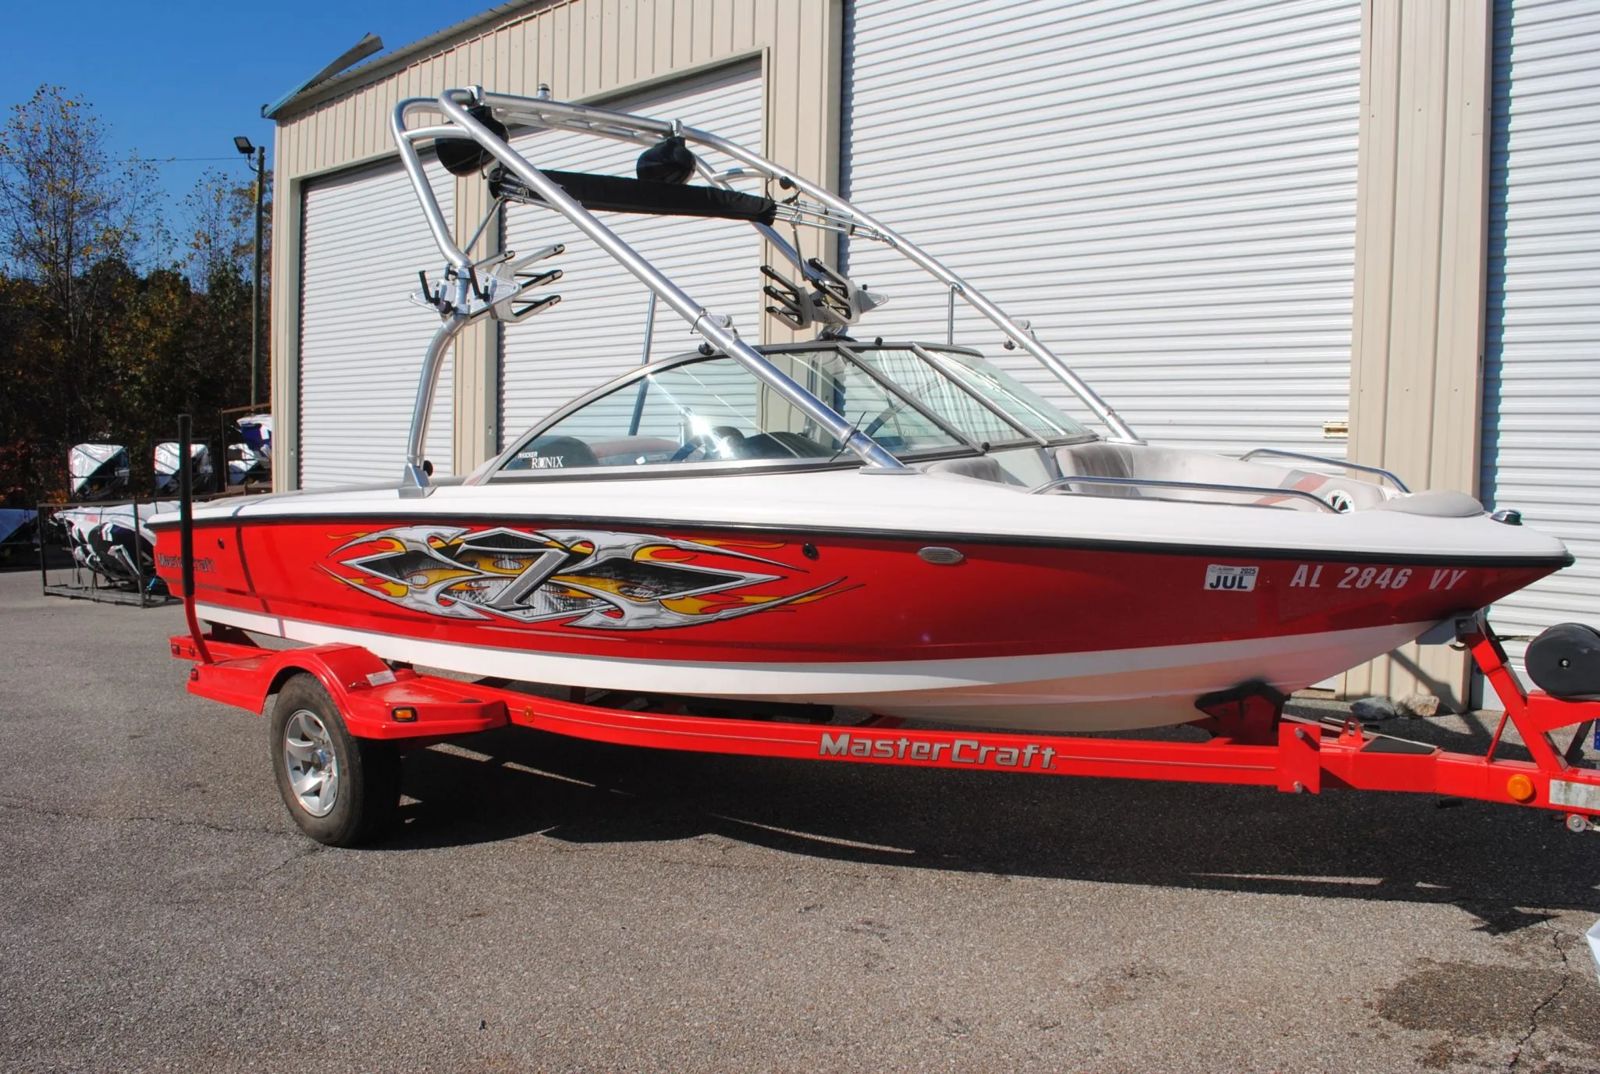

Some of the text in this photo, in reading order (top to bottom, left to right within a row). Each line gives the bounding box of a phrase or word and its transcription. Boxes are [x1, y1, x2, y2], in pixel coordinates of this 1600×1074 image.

[1209, 576, 1248, 589] JUL
[1290, 565, 1467, 590] AL 2846 VY
[819, 733, 1056, 769] MasterCraft
